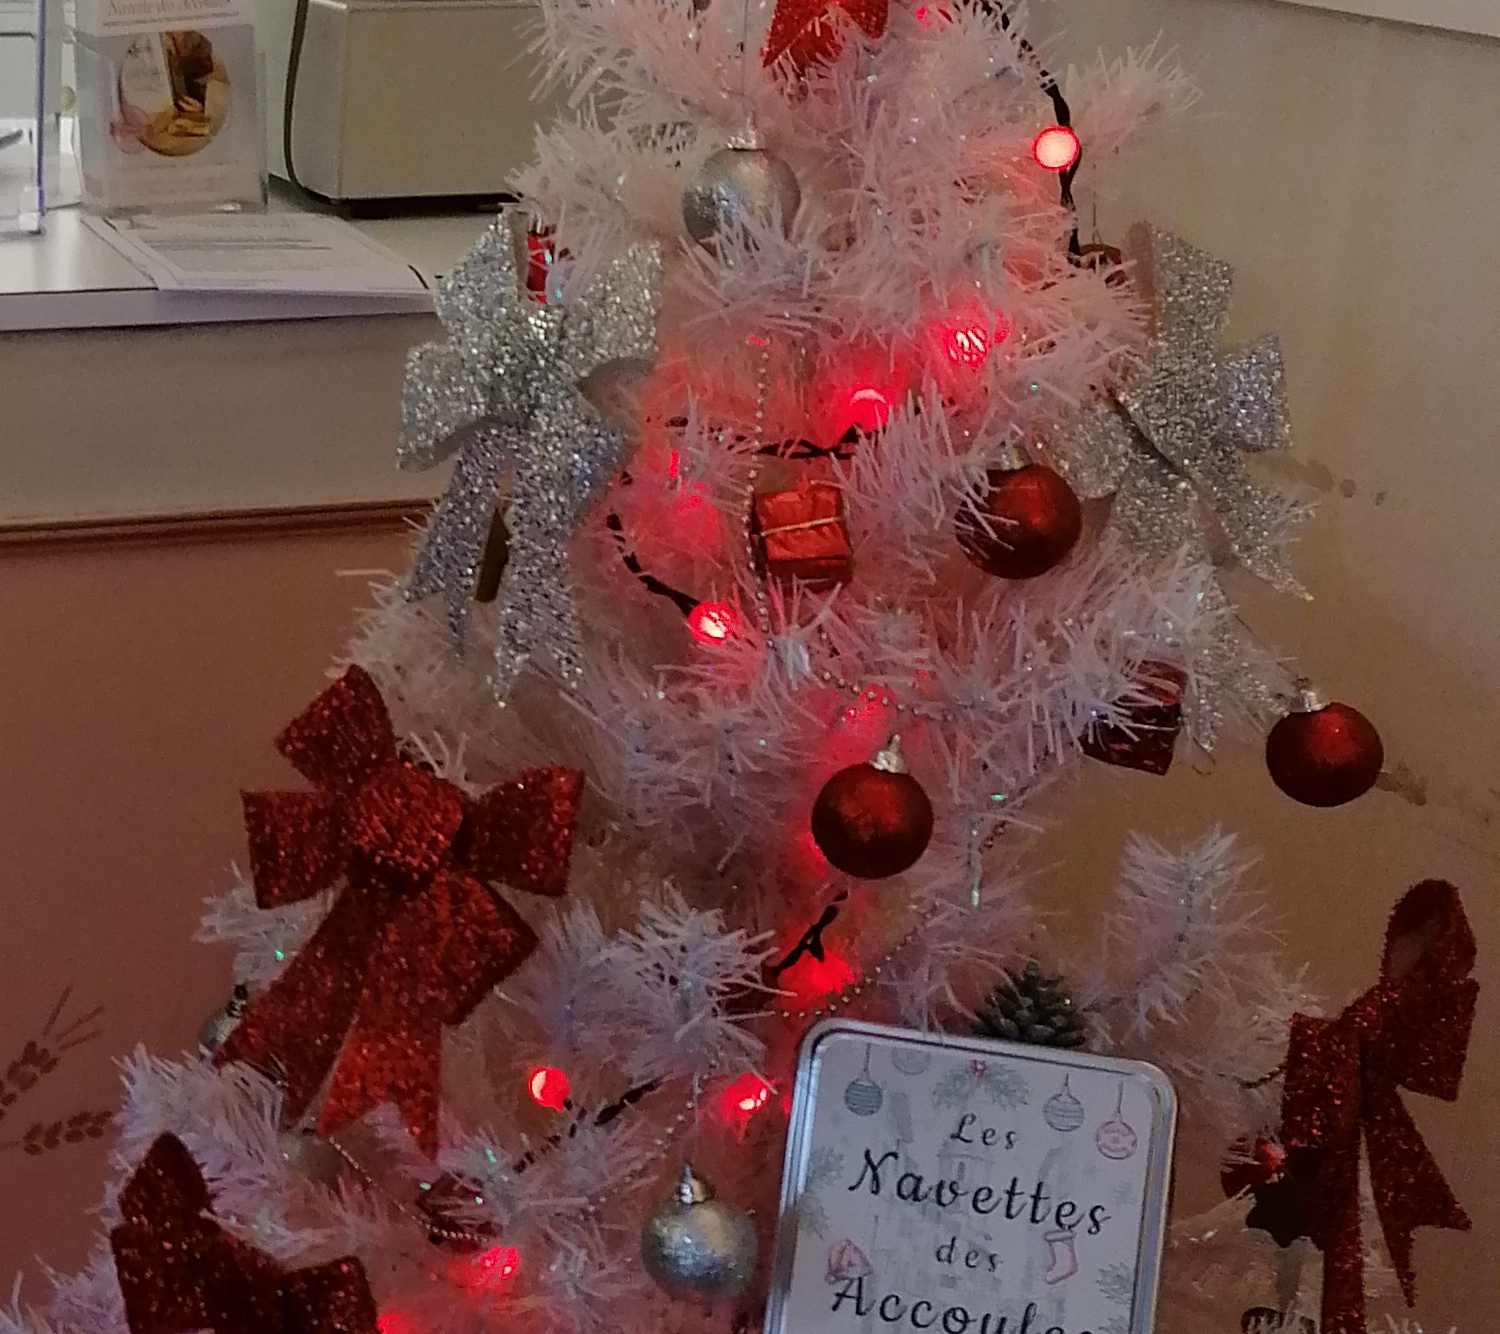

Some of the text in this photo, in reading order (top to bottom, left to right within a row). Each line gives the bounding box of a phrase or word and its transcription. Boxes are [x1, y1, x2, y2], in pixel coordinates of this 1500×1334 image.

[950, 1113, 1018, 1151] Les
[848, 1148, 1112, 1236] Navettes
[936, 1236, 1001, 1273] des
